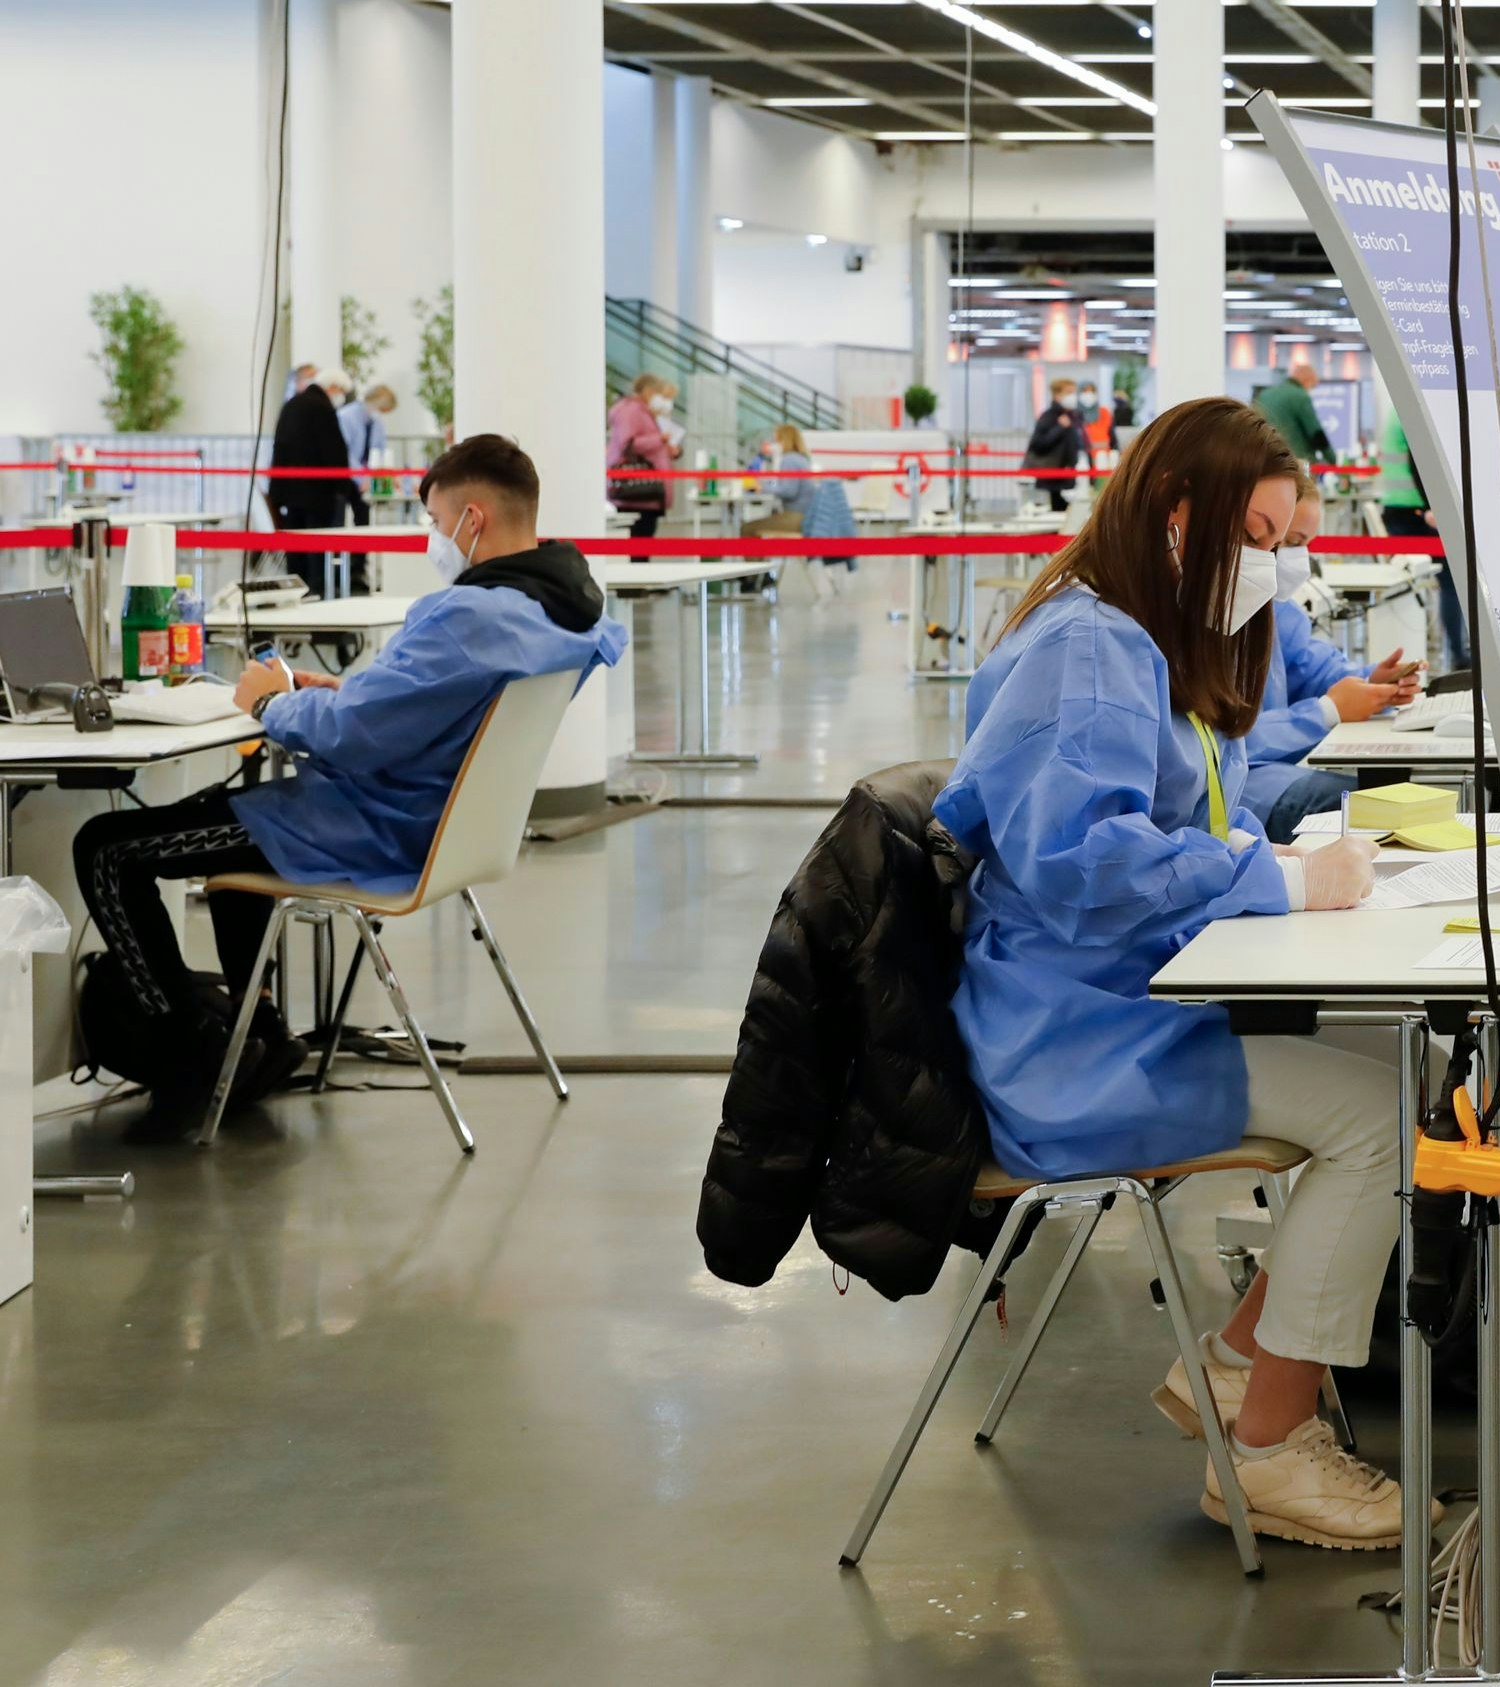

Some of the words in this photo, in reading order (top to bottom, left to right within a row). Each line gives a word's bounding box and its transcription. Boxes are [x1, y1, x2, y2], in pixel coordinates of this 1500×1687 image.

[1353, 231, 1400, 252] tation
[1397, 233, 1412, 253] 2
[1374, 276, 1399, 294] igen
[1397, 277, 1414, 292] Sie
[1415, 281, 1433, 293] uns
[1431, 279, 1449, 294] bitt
[1411, 360, 1450, 378] mpfpass
